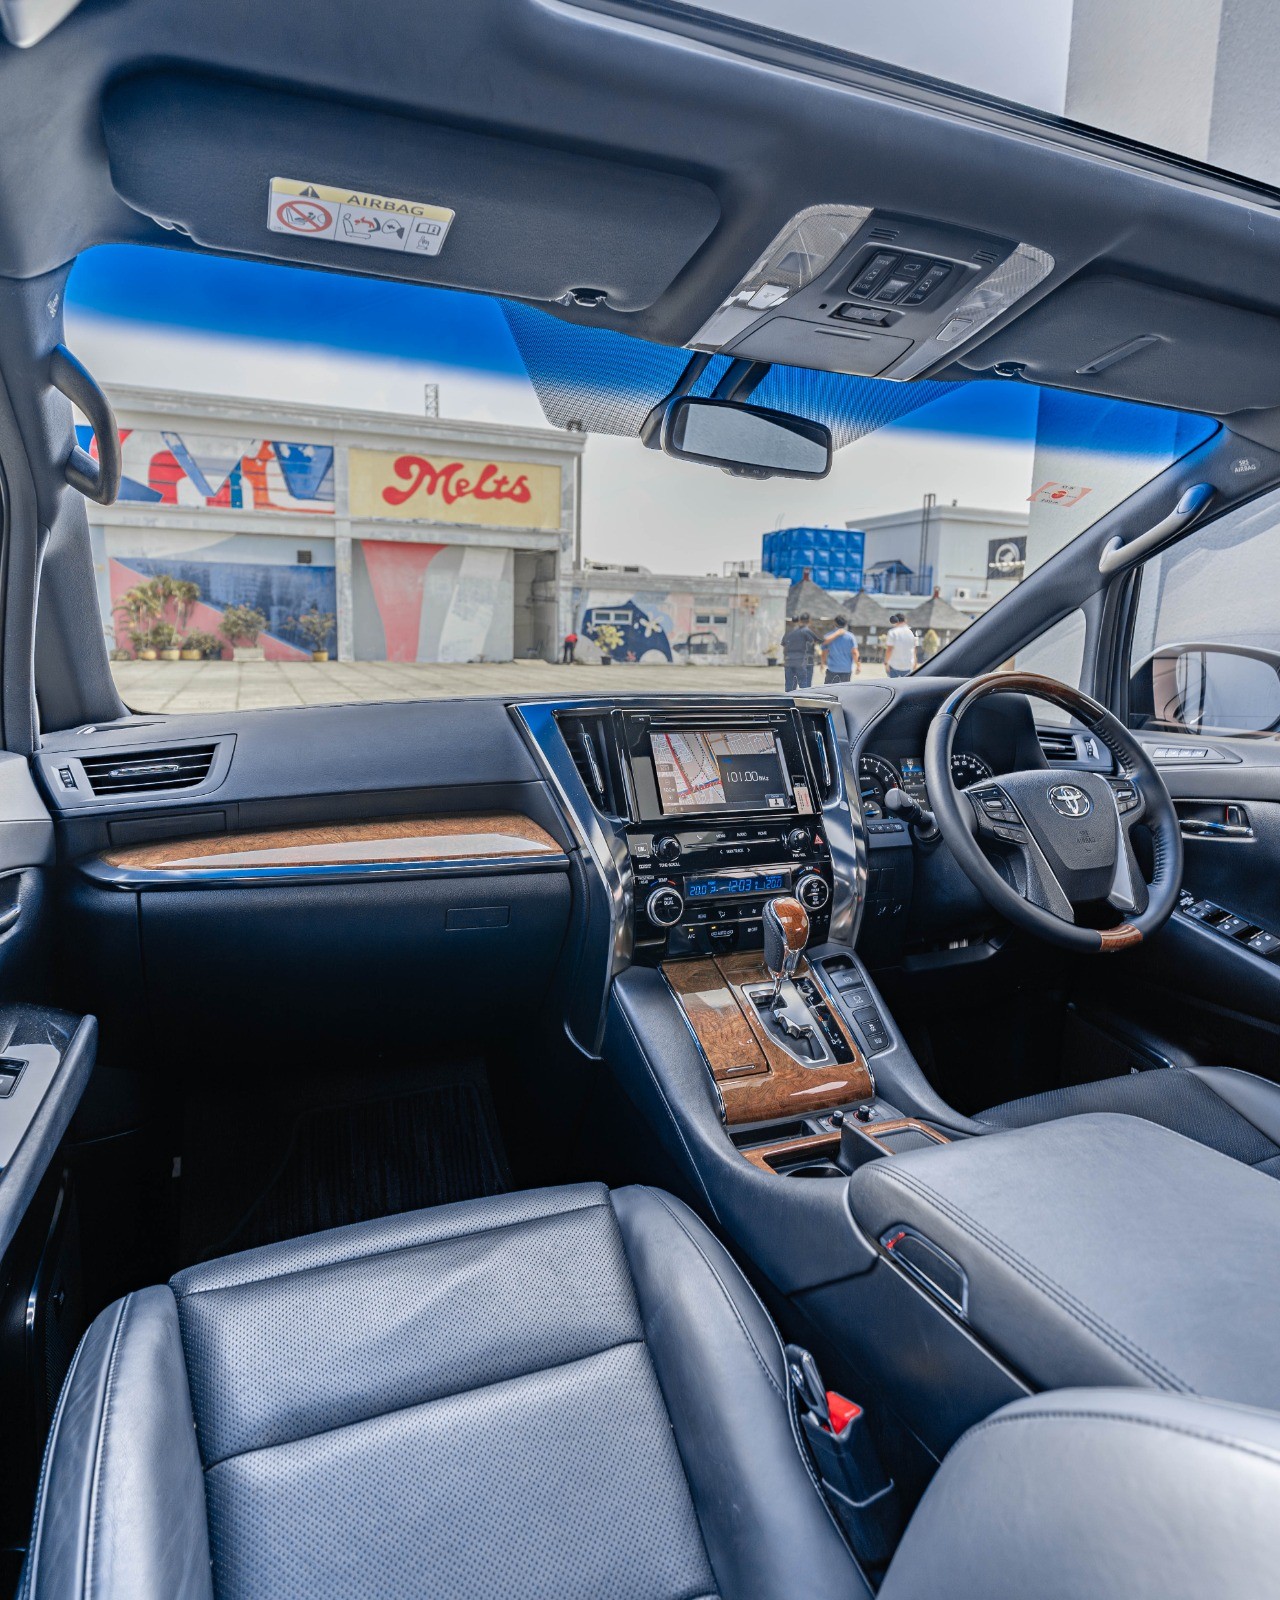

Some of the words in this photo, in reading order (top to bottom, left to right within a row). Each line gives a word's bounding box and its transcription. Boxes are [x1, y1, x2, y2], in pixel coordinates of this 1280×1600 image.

[346, 194, 425, 216] AIRBAG
[1234, 464, 1257, 473] AIRBAG
[382, 454, 532, 506] Melts
